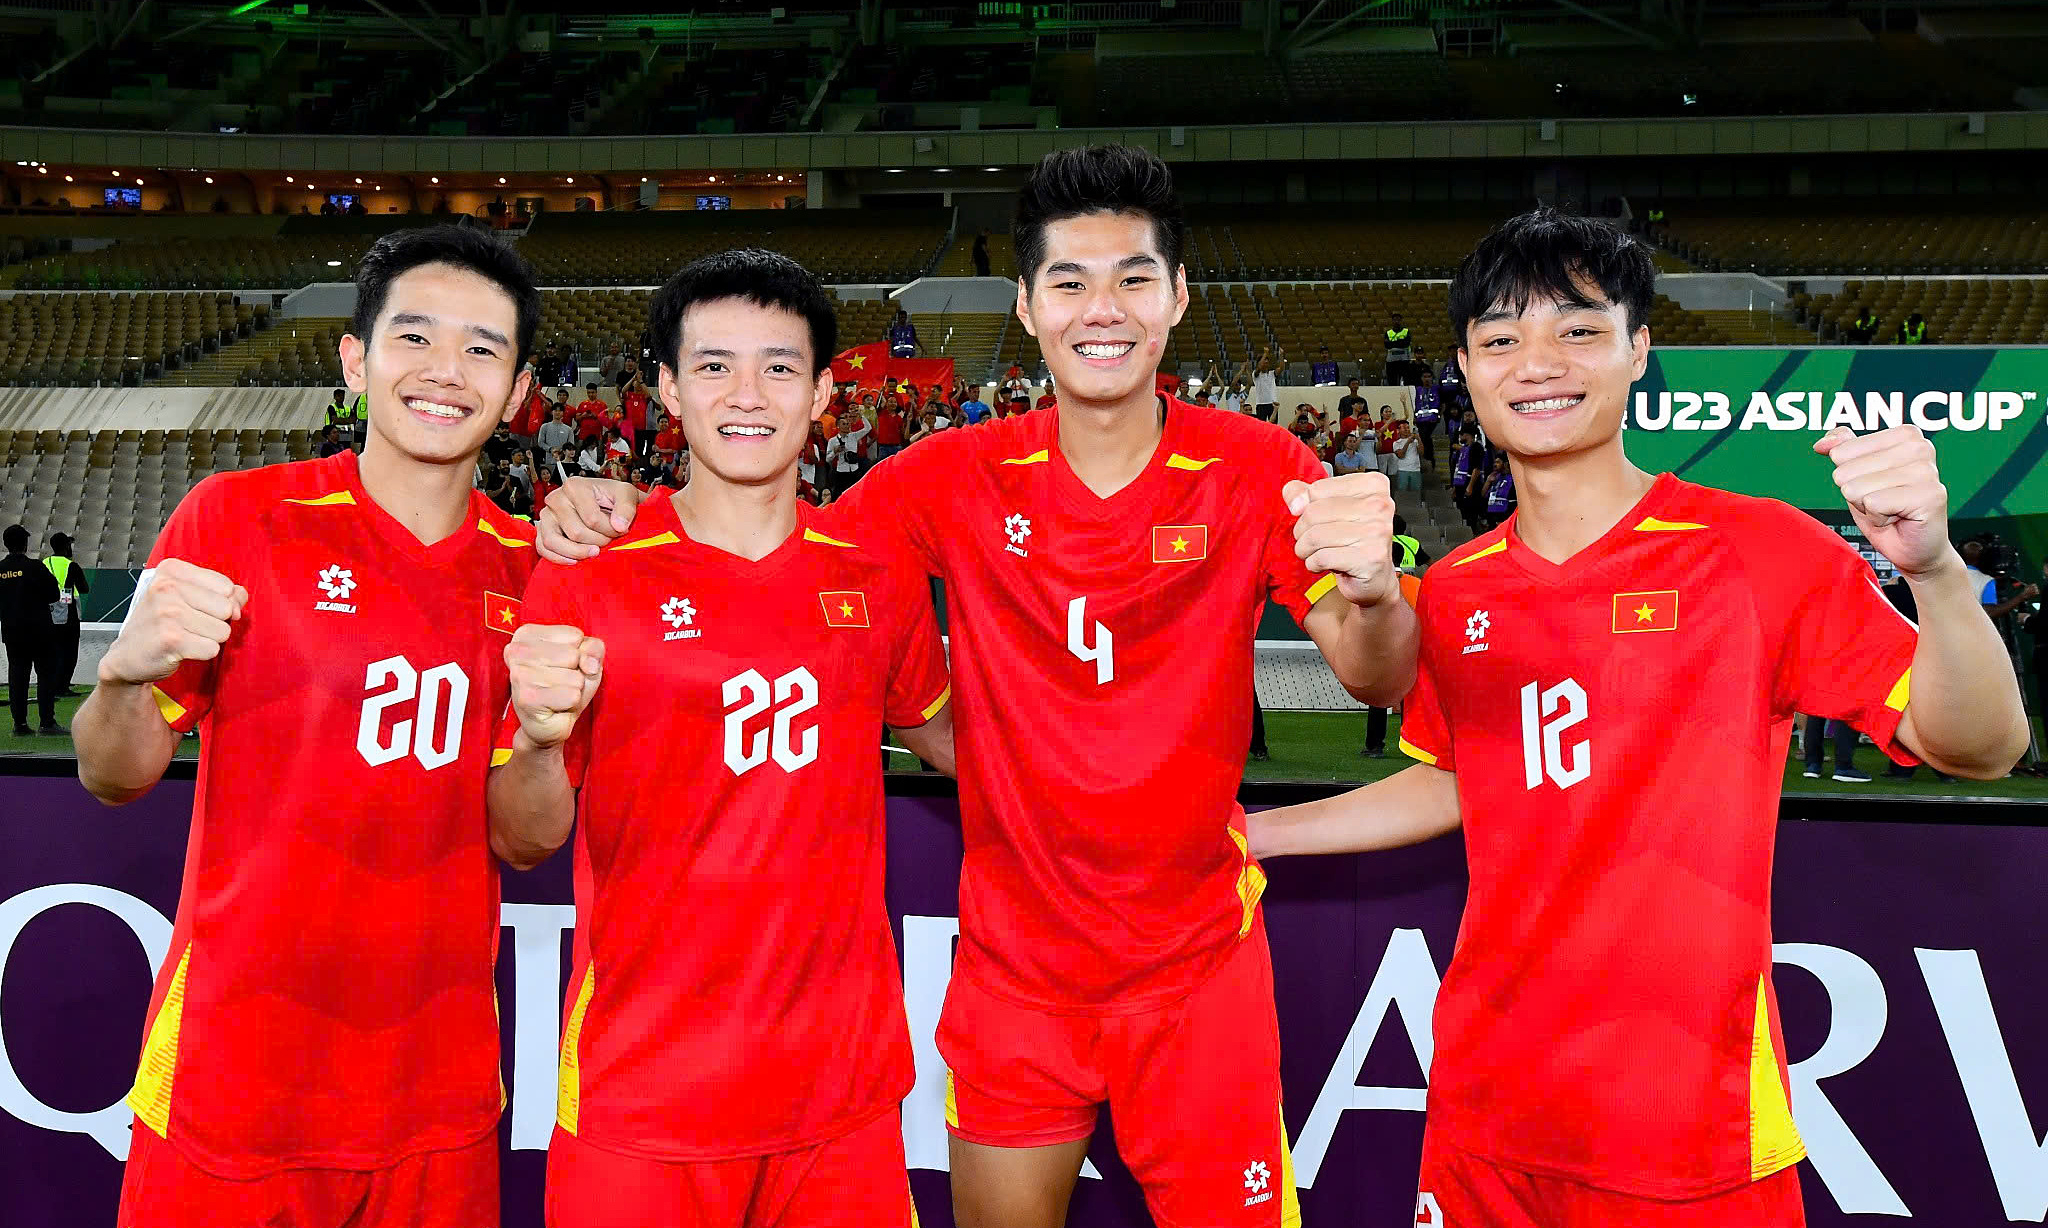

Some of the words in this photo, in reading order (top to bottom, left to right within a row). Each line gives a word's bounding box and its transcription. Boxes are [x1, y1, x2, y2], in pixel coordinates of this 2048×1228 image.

[1636, 391, 1731, 431] U23
[1739, 391, 1904, 431] ASIAN
[0, 570, 23, 580] olice
[1067, 595, 1114, 685] 4
[357, 655, 470, 771] 20
[722, 666, 819, 776] 22
[1520, 677, 1591, 791] 12
